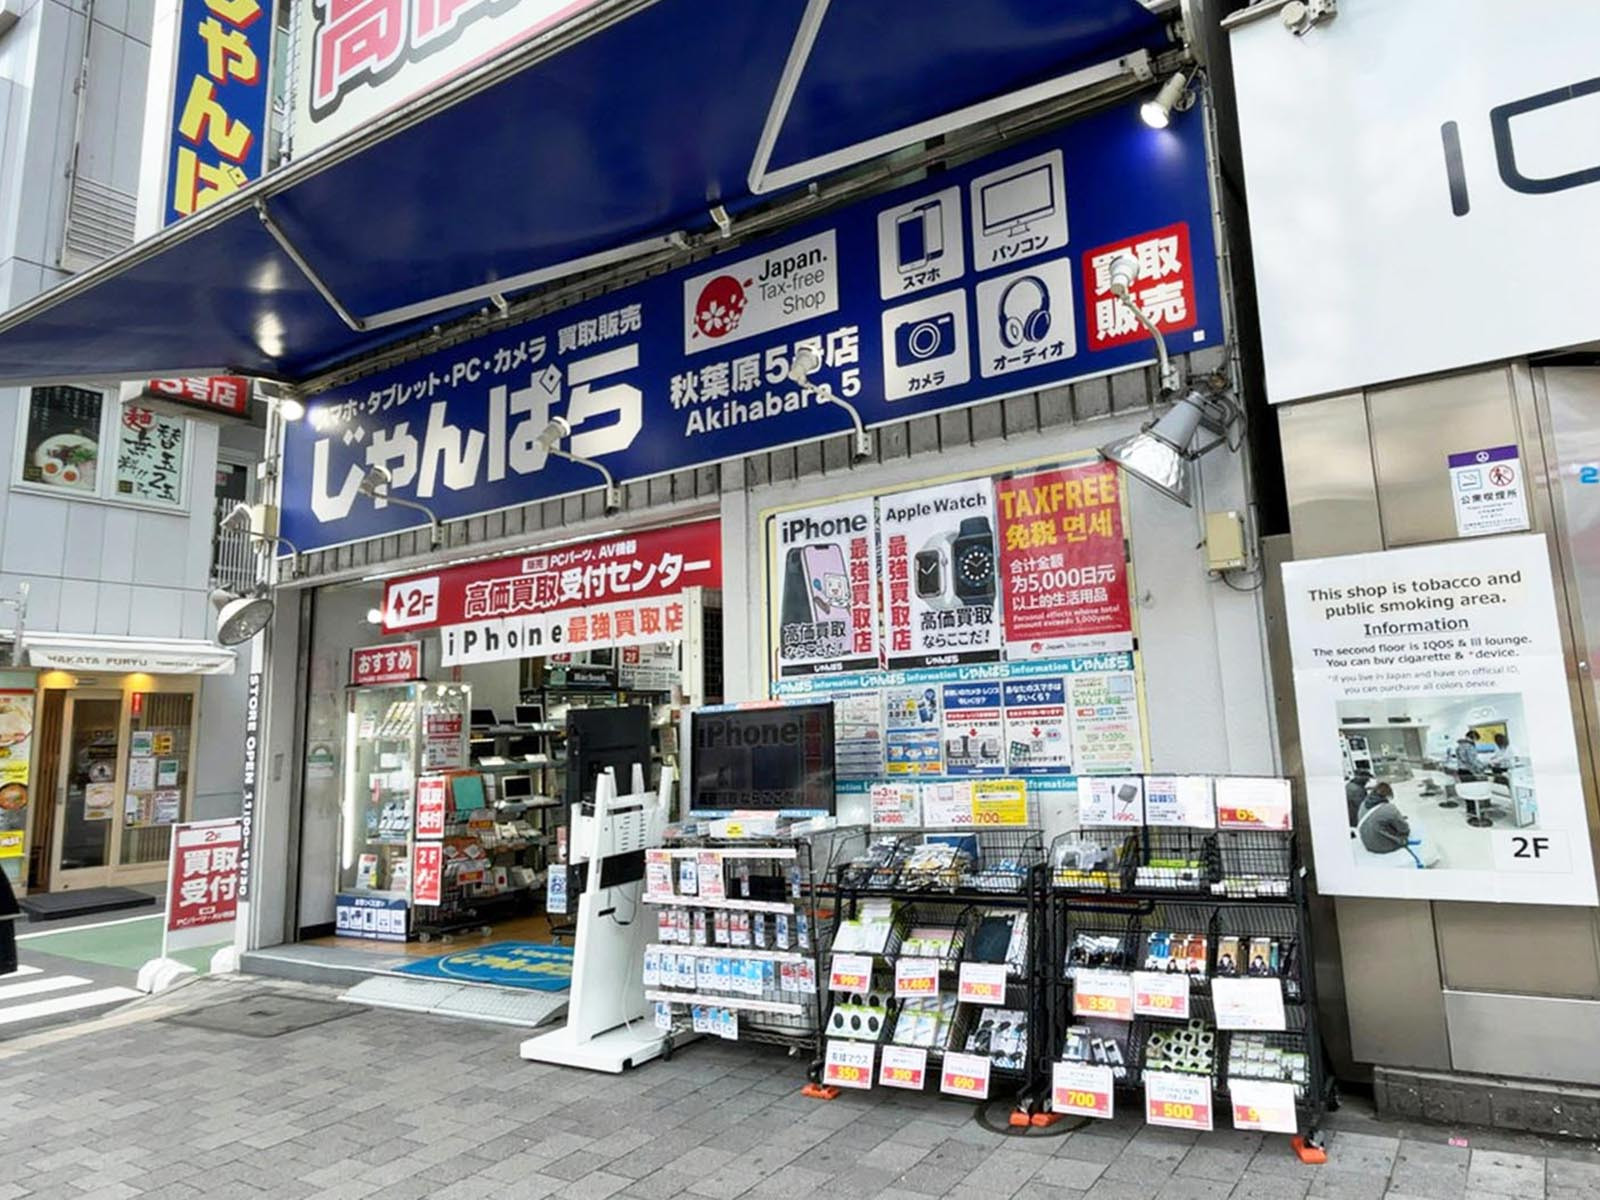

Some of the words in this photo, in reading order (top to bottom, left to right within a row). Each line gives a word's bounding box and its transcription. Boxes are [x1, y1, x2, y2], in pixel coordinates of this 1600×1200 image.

[172, 0, 263, 217] ゃんぱ
[992, 236, 1049, 261] パソコン
[758, 248, 828, 281] Japan.
[759, 269, 825, 301] Tax-free
[902, 268, 941, 290] スマホ
[782, 290, 826, 315] Shop
[1095, 281, 1188, 340] 販売
[557, 303, 642, 355] 買取販売
[993, 341, 1066, 371] オーディオ
[907, 372, 946, 392] カメラ
[685, 383, 832, 437] Akihabara
[842, 368, 861, 397] 5
[311, 342, 643, 522] じゃんぱら
[886, 503, 932, 521] Apple
[934, 493, 987, 513] Watch
[1000, 473, 1116, 519] TAXFREE
[782, 514, 867, 543] iPhone
[1063, 509, 1114, 543] 면세
[465, 552, 712, 618] 高価買取受付センター
[850, 537, 872, 653] 最強買取店
[888, 535, 912, 652] 最強買取店
[1308, 587, 1343, 602] This
[1347, 583, 1388, 600] shop
[1393, 582, 1407, 595] is
[1412, 575, 1482, 592] tobacco
[1487, 570, 1522, 586] and
[408, 590, 433, 616] 2F
[1325, 600, 1376, 620] public
[1379, 595, 1455, 614] smoking
[1460, 592, 1507, 606] area.
[784, 621, 846, 642] 高価買取
[920, 608, 993, 631] 高価買取
[1364, 617, 1470, 638] Information
[923, 630, 990, 649] ならここだ!
[1312, 648, 1334, 657] The
[1336, 645, 1376, 656] second
[1379, 642, 1406, 653] floor
[1409, 642, 1420, 651] is
[1423, 640, 1455, 652] IQOS
[1458, 639, 1467, 648] &
[1485, 634, 1533, 648] lounge.
[358, 649, 412, 675] おすすめ
[959, 664, 1010, 680] じゃんぱら
[1070, 655, 1130, 672] じゃんぱら
[1326, 659, 1348, 668] You
[1350, 658, 1371, 667] can
[1373, 654, 1395, 666] buy
[1398, 651, 1451, 665] cigarette
[1454, 650, 1464, 660] &
[247, 673, 260, 731] STORE
[700, 720, 799, 748] iPhone
[244, 736, 257, 785] OPEN
[976, 812, 999, 824] 700
[1512, 837, 1550, 858] 2F
[183, 846, 240, 878] 買取
[179, 874, 238, 907] 受付
[1067, 1091, 1096, 1107] 700
[1163, 1104, 1194, 1119] 500
